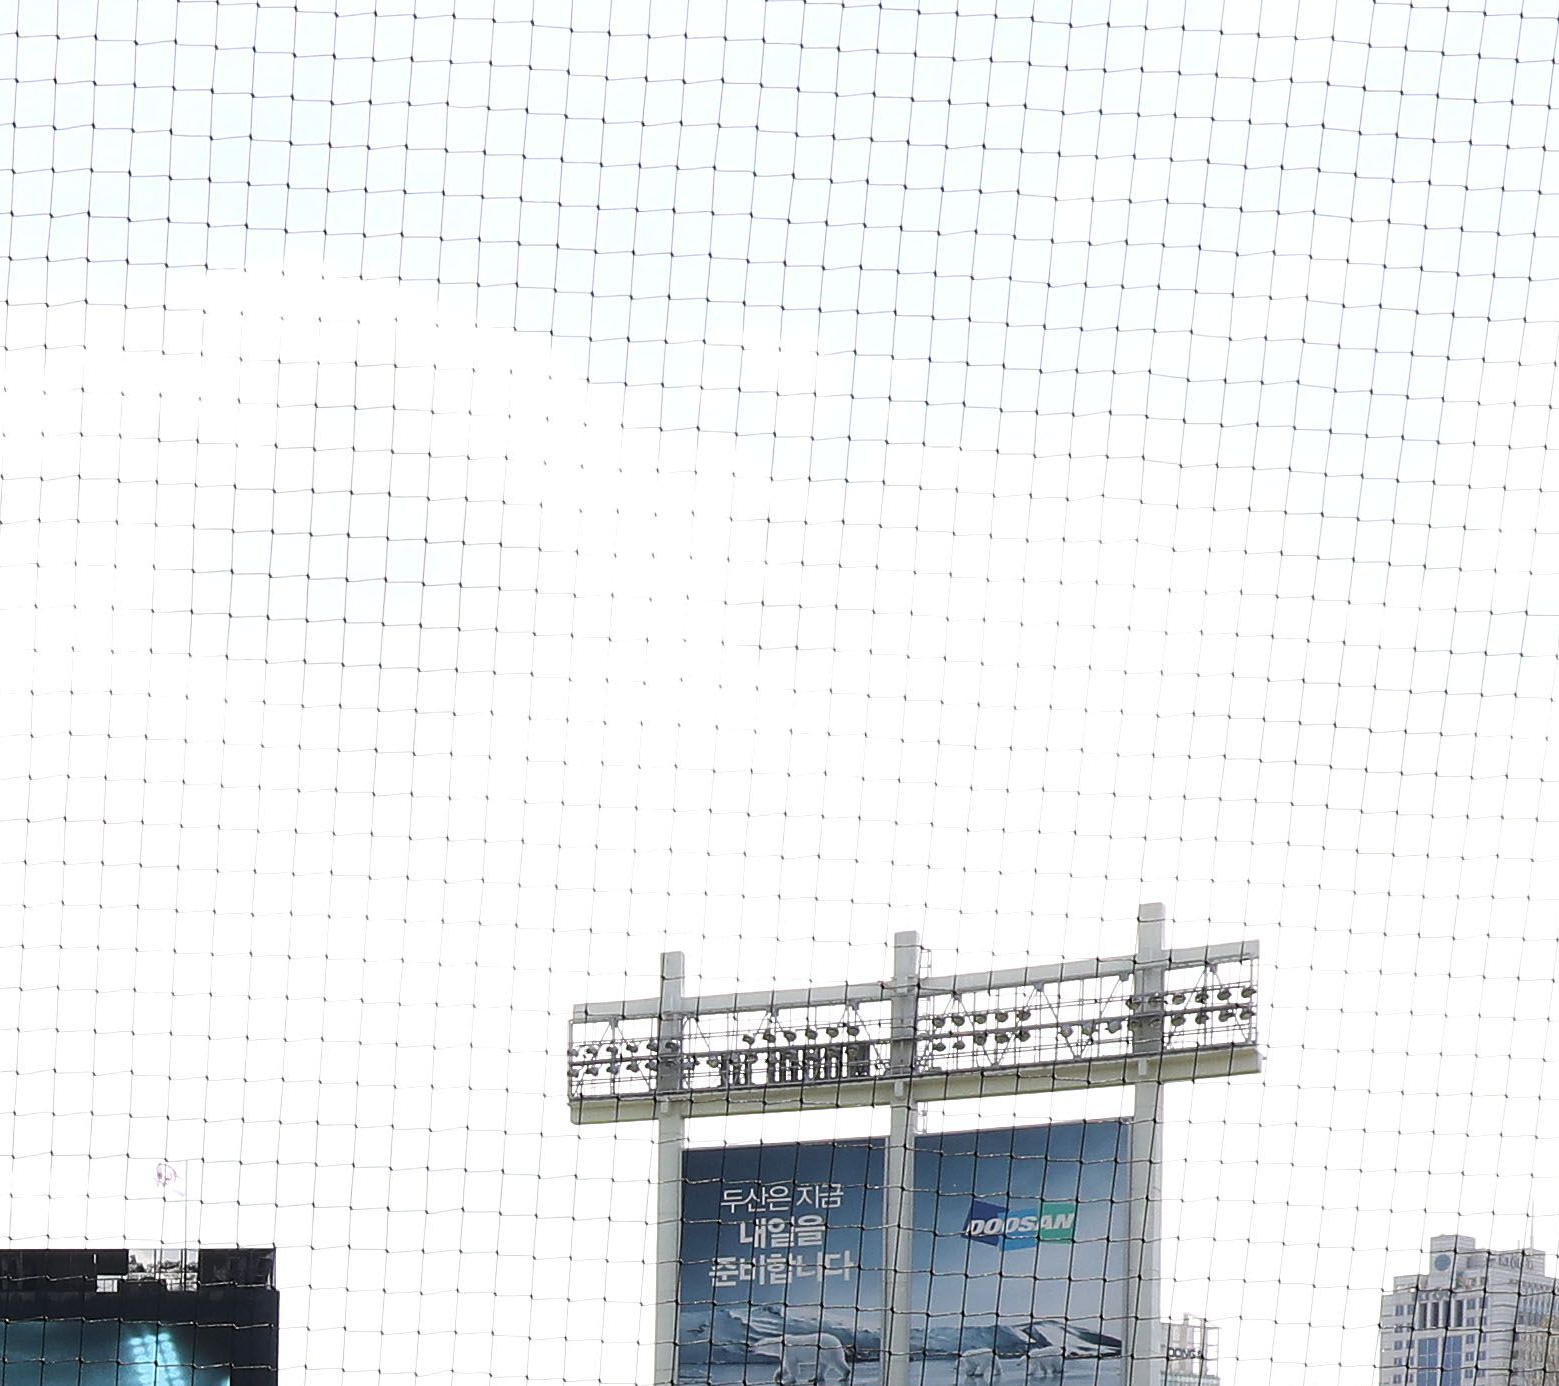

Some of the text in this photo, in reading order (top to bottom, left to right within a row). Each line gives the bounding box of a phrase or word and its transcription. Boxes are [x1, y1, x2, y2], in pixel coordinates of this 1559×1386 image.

[719, 1182, 844, 1213] 두산은 지금
[738, 1214, 826, 1250] 내일을
[965, 1212, 1075, 1238] DOOSAN
[707, 1249, 854, 1289] 준비합니다
